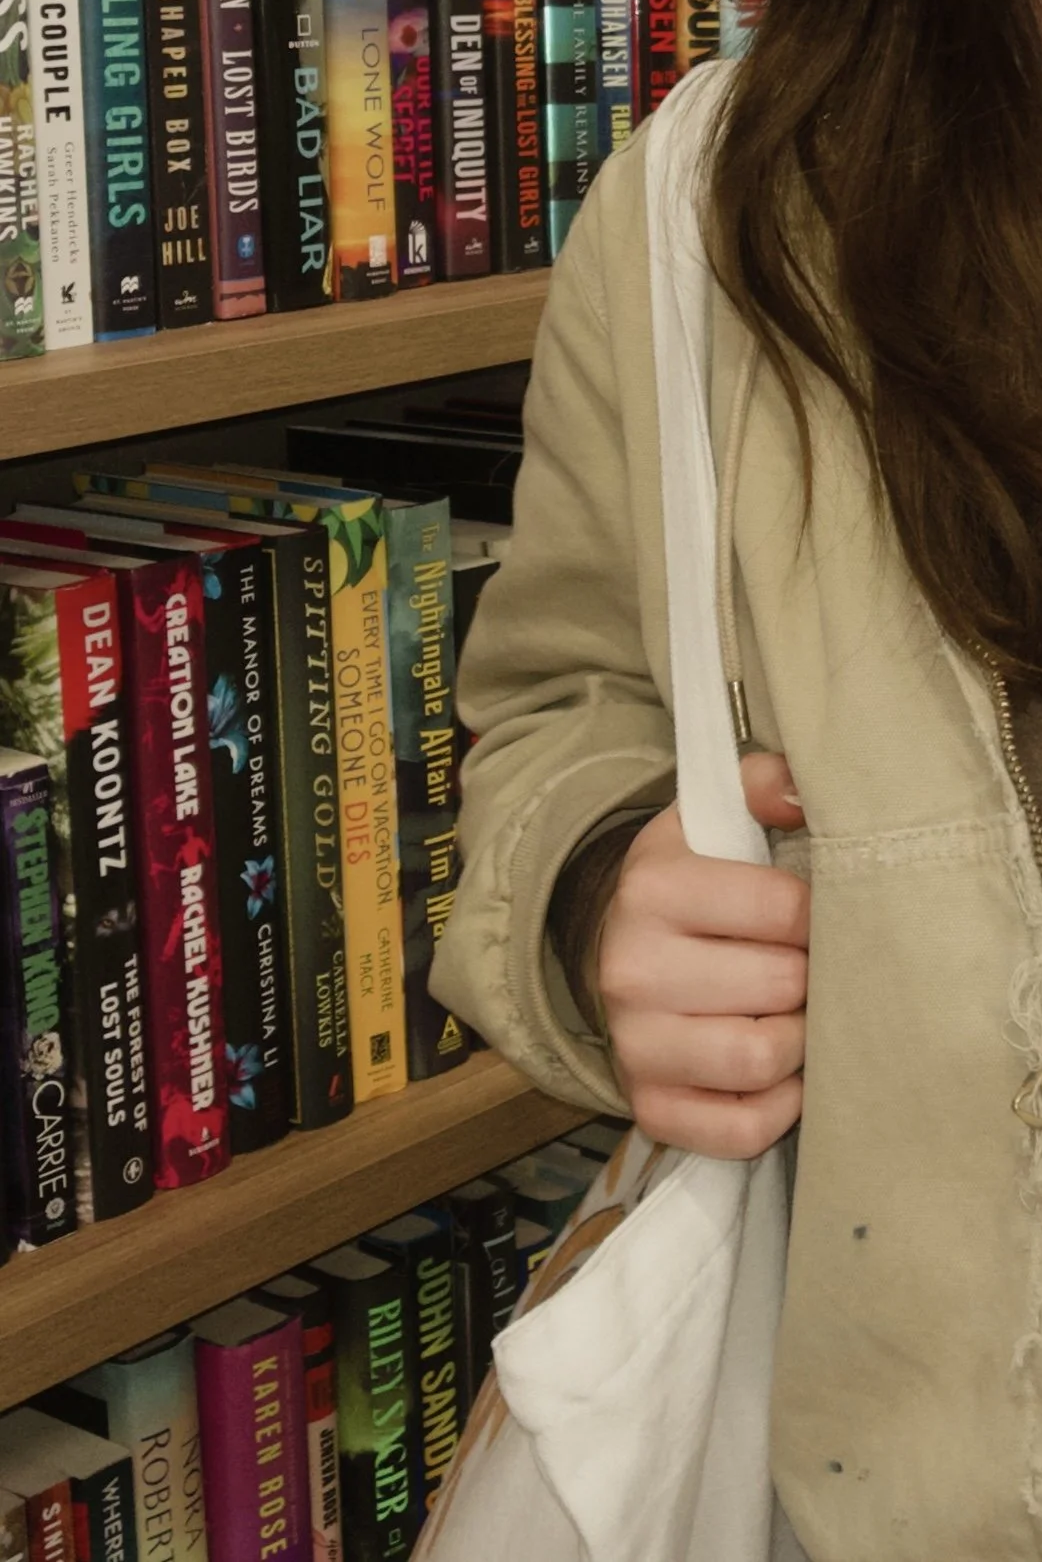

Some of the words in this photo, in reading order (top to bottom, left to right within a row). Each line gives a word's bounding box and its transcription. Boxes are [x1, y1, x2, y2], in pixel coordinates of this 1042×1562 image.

[39, 2, 71, 125] COUPLE
[361, 27, 383, 113] LONE
[450, 13, 483, 72] DEN
[573, 27, 588, 97] FAMILY
[221, 49, 255, 118] LOST
[294, 67, 321, 159] BAD
[459, 75, 478, 95] OF
[46, 146, 58, 188] Sarah
[64, 141, 75, 185] Greer
[104, 105, 146, 229] GIRLS
[166, 118, 192, 175] BOX
[225, 127, 259, 214] BIRDS
[365, 121, 386, 212] WOLF
[452, 98, 487, 223] INIQUITY
[48, 192, 60, 263] Pekkanen
[66, 189, 79, 265] Hendricks
[164, 204, 200, 233] JOE
[297, 173, 326, 274] LIAR
[518, 166, 540, 229] GIRLS
[161, 237, 207, 267] HILL
[239, 564, 257, 606] THE
[82, 601, 117, 709] DEAN
[165, 592, 196, 740] CREATION
[242, 615, 260, 705] MANOR
[303, 556, 332, 756] SPITTING
[365, 656, 383, 704] TIME
[246, 713, 263, 744] OF
[90, 718, 128, 878] KOONTZ
[172, 744, 199, 822] LAKE
[249, 754, 268, 848] DREAMS
[343, 800, 372, 866] DIES
[180, 862, 207, 974] RACHEL
[100, 981, 122, 1041] LOST
[123, 952, 139, 1004] THE
[256, 922, 278, 1041] CHRISTINA
[315, 971, 334, 1049] LOWKIS
[333, 949, 350, 1059] CARMELLA
[359, 951, 375, 999] MACK
[128, 1008, 146, 1097] FOREST
[186, 976, 215, 1113] KUSHNER
[263, 1045, 279, 1070] LI
[104, 1046, 127, 1128] SOULS
[132, 1100, 148, 1133] OF
[32, 1079, 67, 1199] CARRIE
[368, 1297, 404, 1396] RILEY
[416, 1256, 456, 1360] JOHN
[252, 1354, 279, 1466] KAREN
[319, 1427, 335, 1484] JENEVA
[258, 1473, 288, 1561] ROSE
[321, 1487, 337, 1531] ROSE
